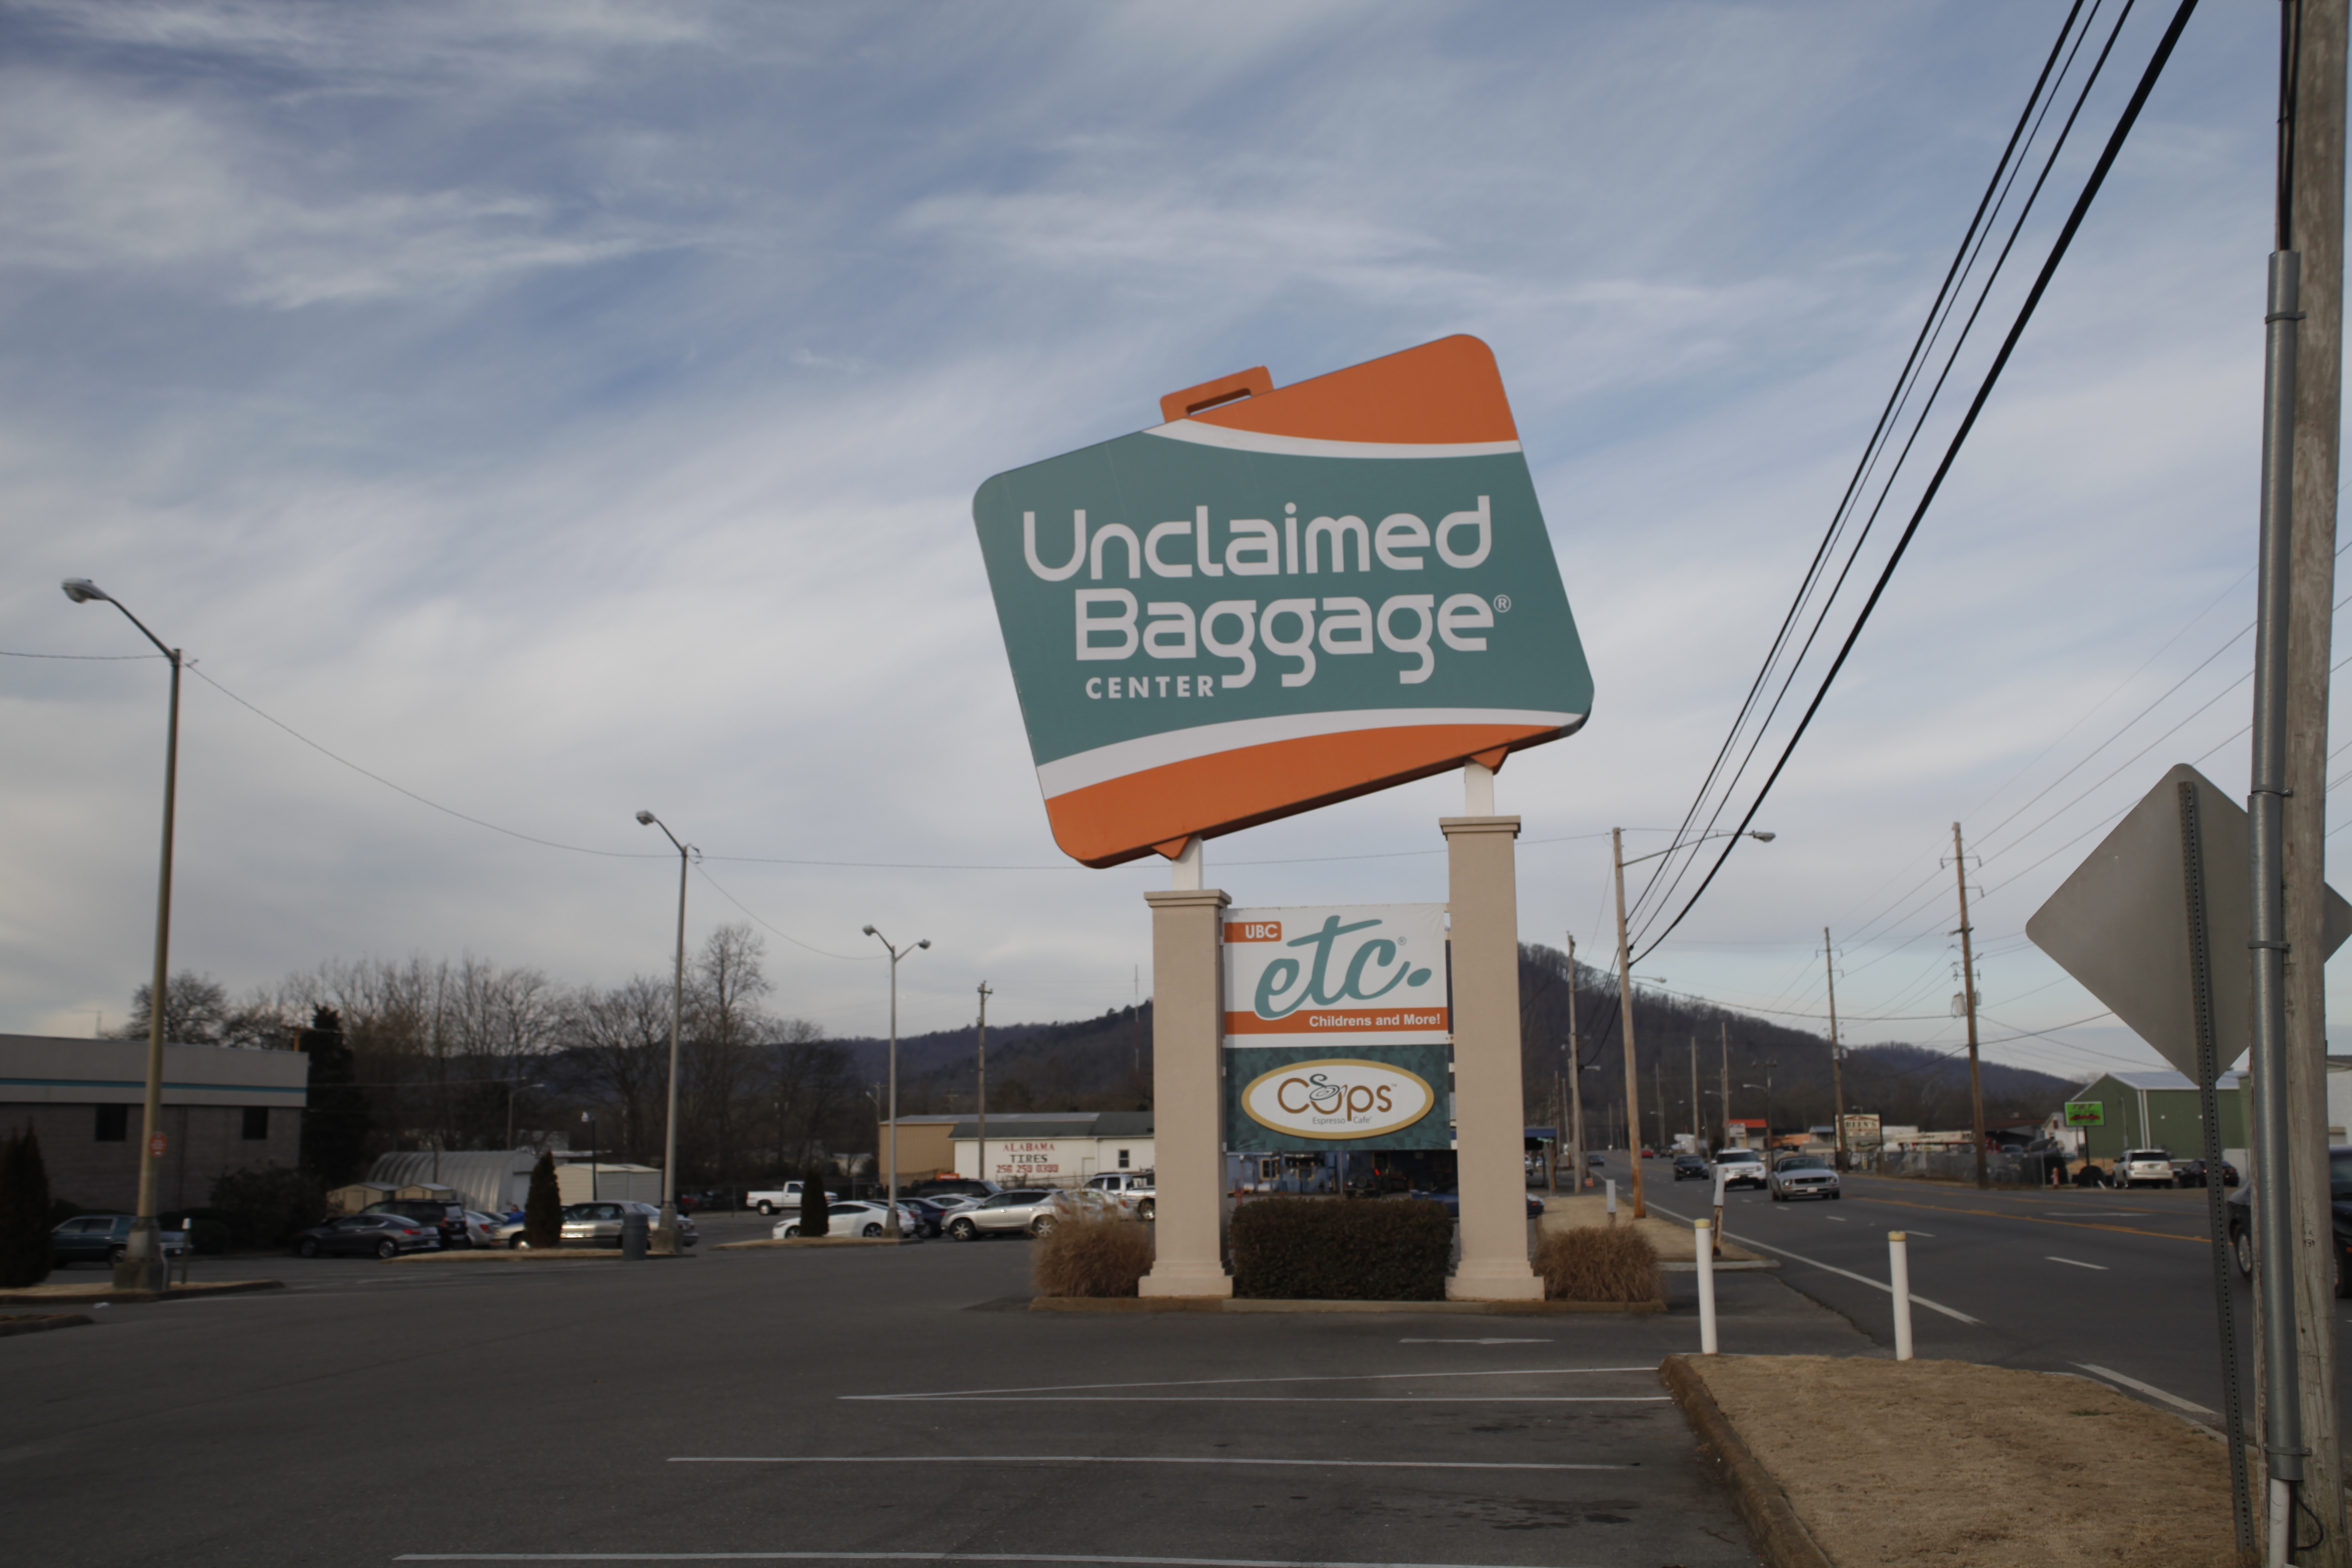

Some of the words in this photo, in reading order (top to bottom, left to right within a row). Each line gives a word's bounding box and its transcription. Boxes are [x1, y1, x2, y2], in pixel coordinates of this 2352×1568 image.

[1023, 495, 1492, 582] Unclaimed
[1085, 676, 1215, 699] CENTER
[1245, 924, 1279, 939] UBC
[1309, 1015, 1372, 1027] Childrens
[1375, 1014, 1400, 1026] and
[1403, 1013, 1441, 1025] More!
[1313, 1117, 1346, 1126] Espresso
[1003, 1142, 1055, 1152] ALABAMA
[1010, 1155, 1048, 1163] TIRES
